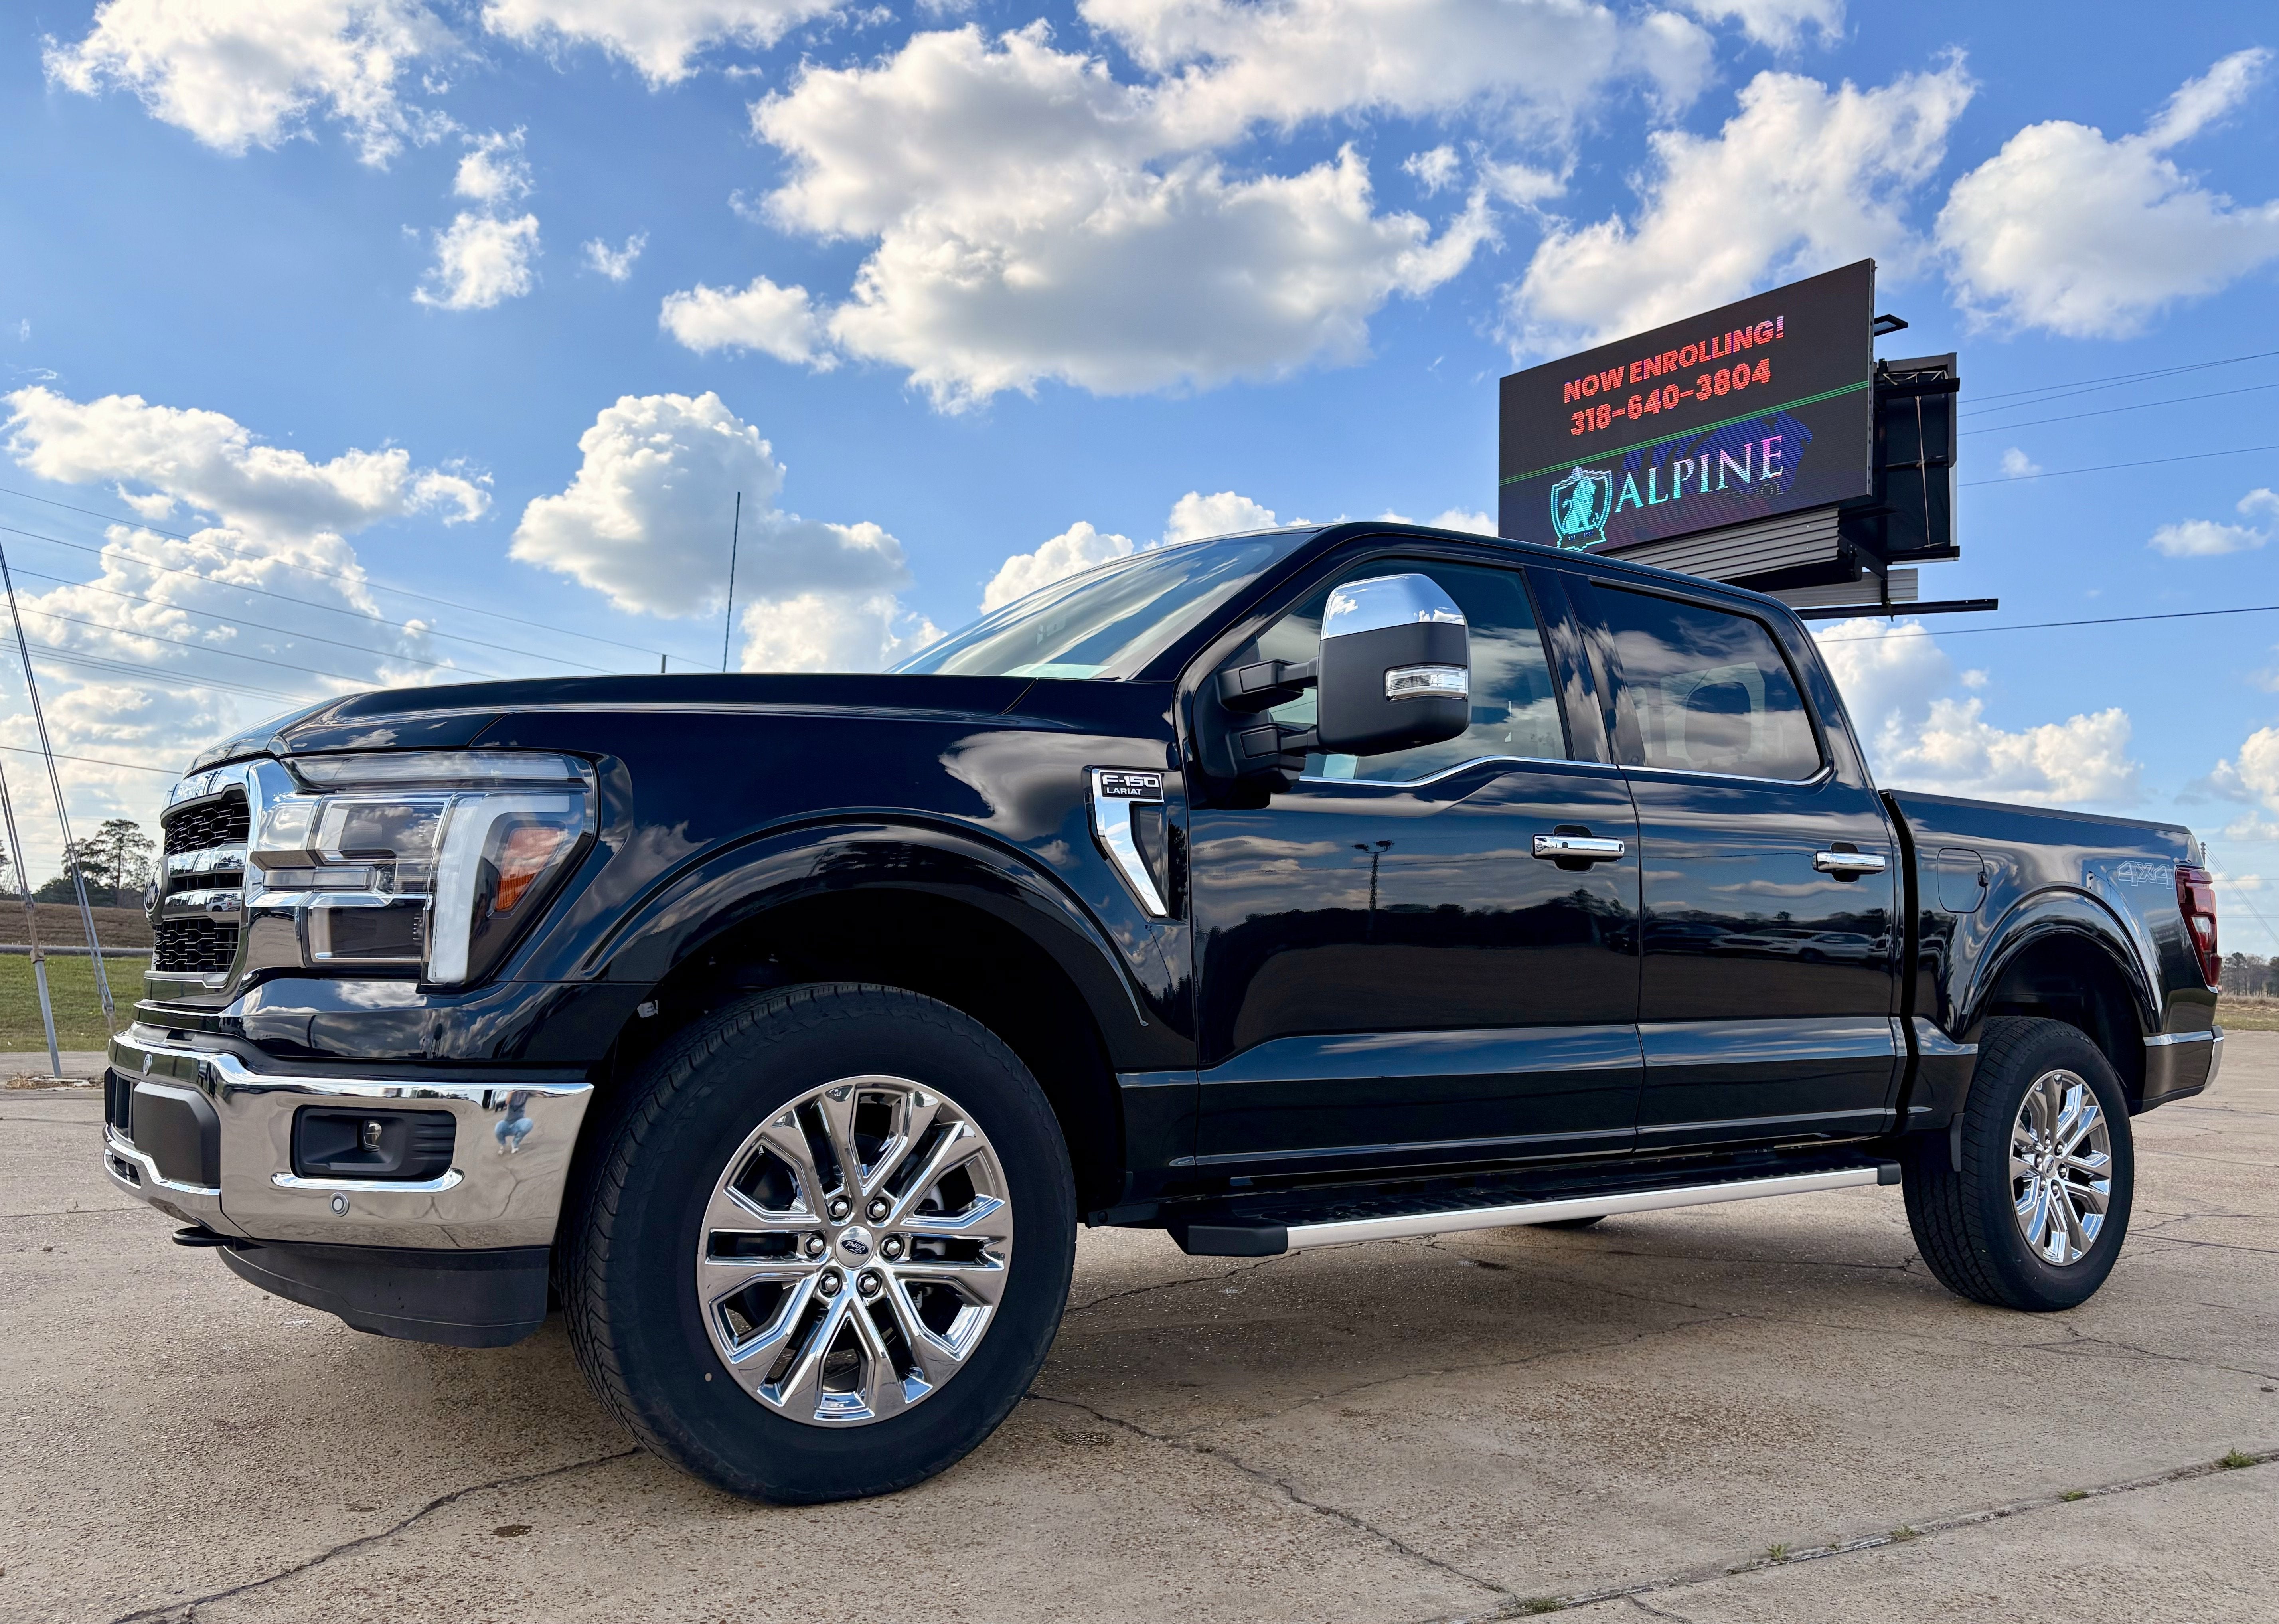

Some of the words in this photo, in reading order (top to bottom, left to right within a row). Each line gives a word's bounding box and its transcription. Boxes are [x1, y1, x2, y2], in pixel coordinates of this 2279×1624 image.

[1564, 365, 1625, 403] NOW
[1629, 315, 1784, 384] ENROLLING!
[1570, 358, 1771, 436] 318-640-3804
[1615, 435, 1783, 513] ALPINE
[1102, 774, 1159, 788] F-150
[1106, 787, 1142, 795] LARIAT
[845, 1240, 866, 1254] Ford
